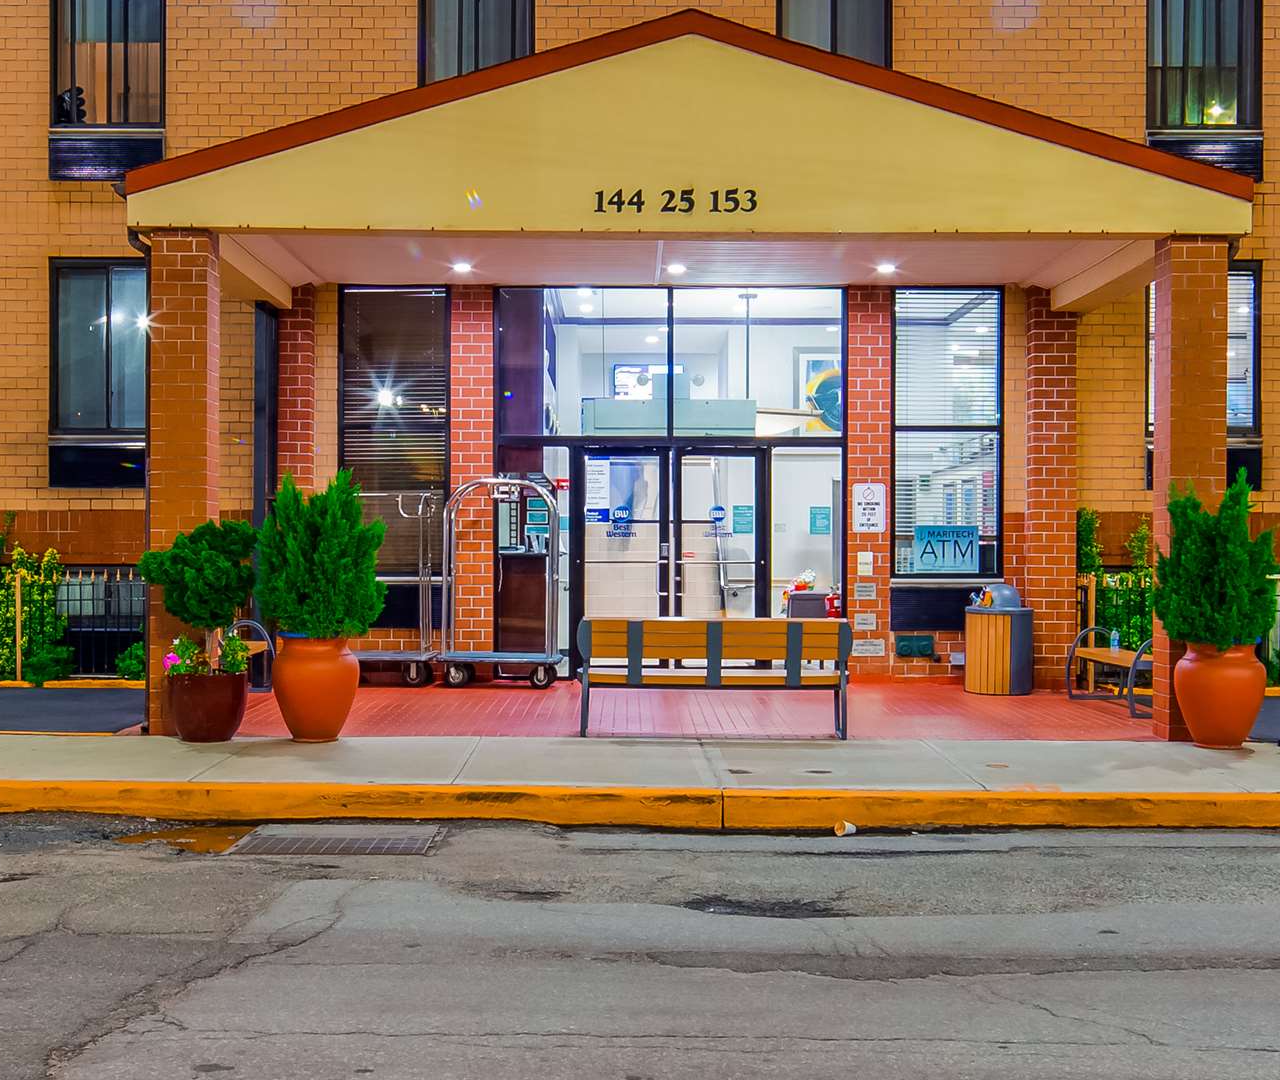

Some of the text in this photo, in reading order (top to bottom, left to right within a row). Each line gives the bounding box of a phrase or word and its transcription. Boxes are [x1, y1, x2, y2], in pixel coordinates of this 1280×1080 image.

[593, 187, 758, 213] 144 25 153
[927, 530, 974, 538] MARITECH
[920, 539, 974, 559] ATM
